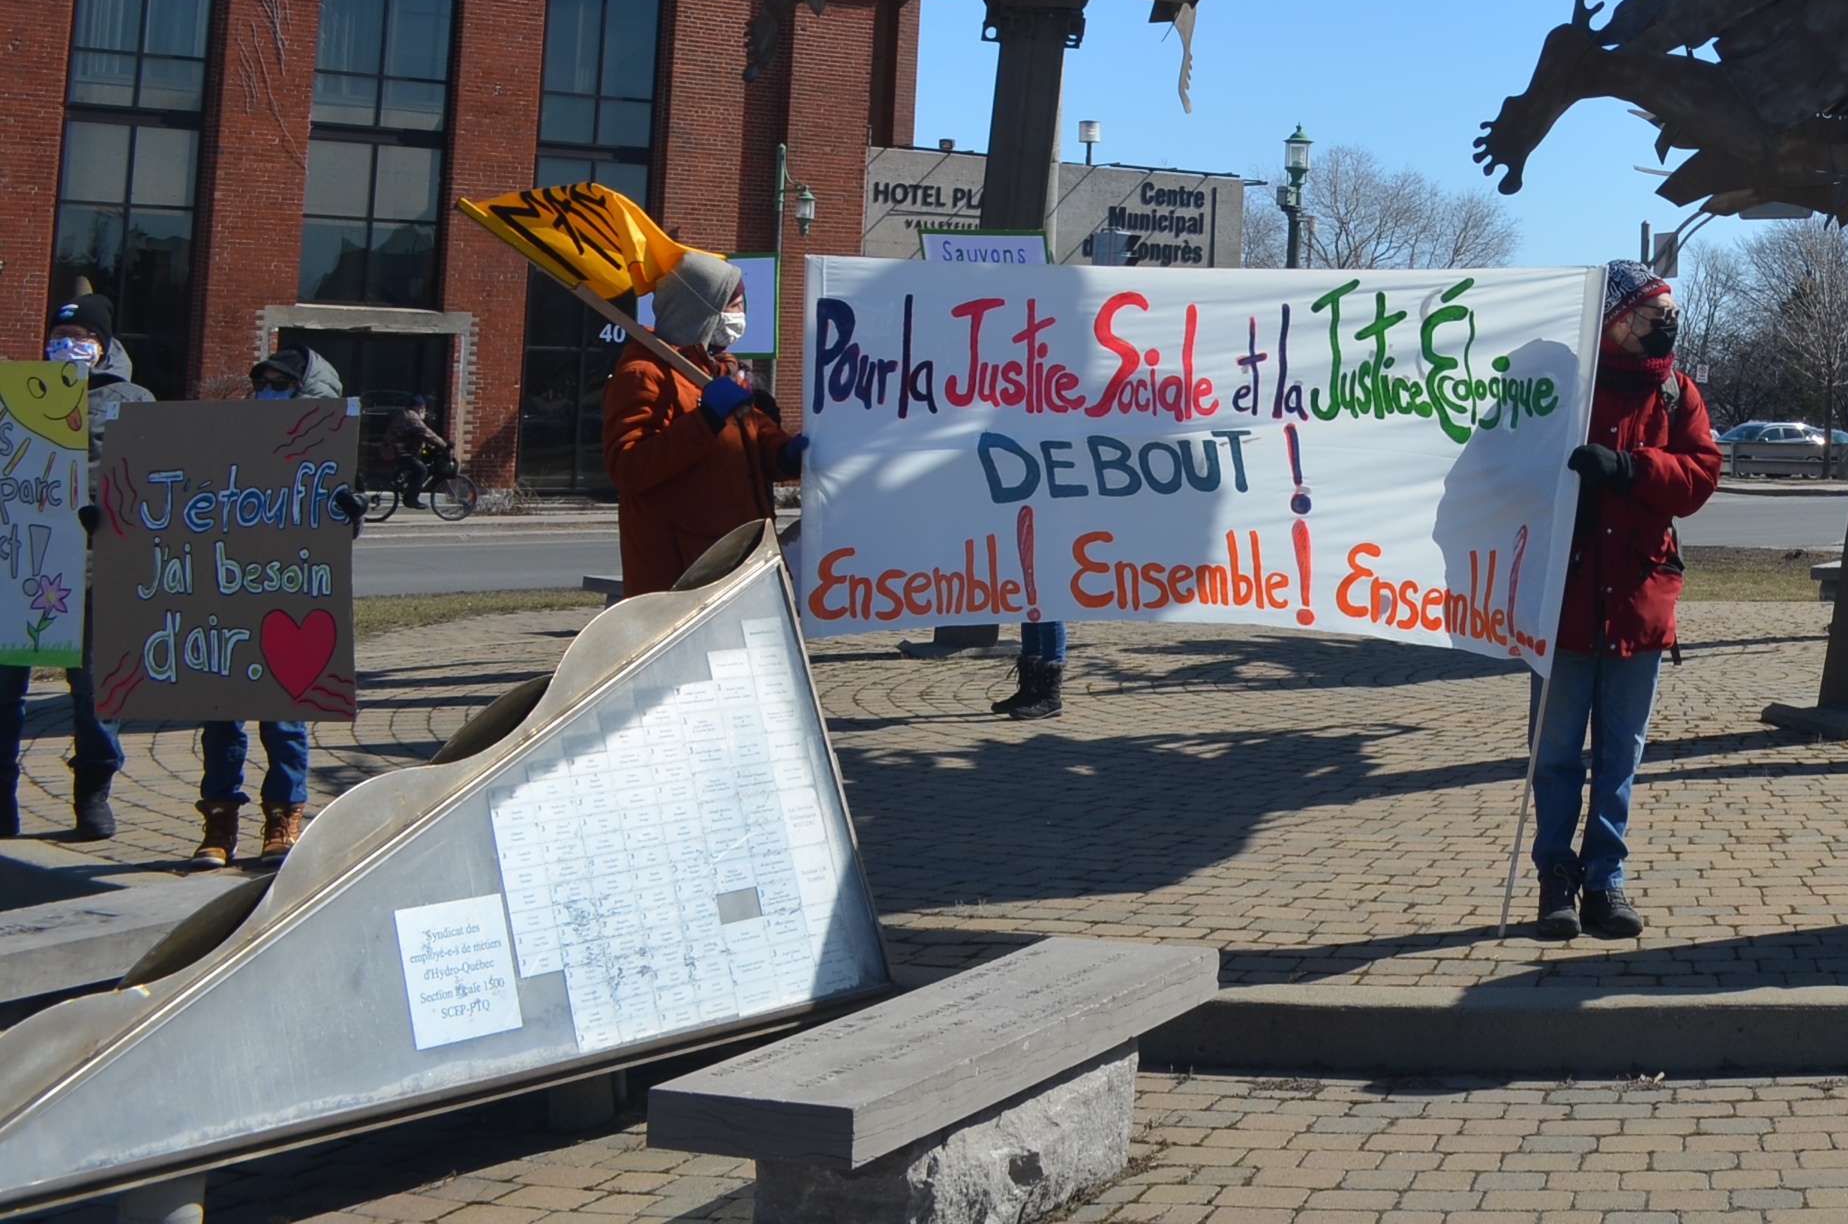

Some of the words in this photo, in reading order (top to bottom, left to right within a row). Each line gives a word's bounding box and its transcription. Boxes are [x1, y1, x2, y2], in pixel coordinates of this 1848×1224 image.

[873, 181, 946, 208] HOTEL
[1140, 181, 1205, 209] Centre
[1107, 205, 1204, 238] Municipal
[942, 240, 1026, 265] Sauvons
[1137, 239, 1203, 266] ongrès
[813, 297, 898, 415] Pour
[945, 297, 1086, 415] Justice
[1085, 290, 1220, 423] Sociale
[1231, 316, 1267, 416] et
[1272, 302, 1309, 421] la
[1310, 278, 1430, 423] Justice
[977, 429, 1251, 504] DEBOUT
[215, 540, 333, 597] besoin
[808, 505, 1042, 622] Ensemble!
[1070, 517, 1316, 626] Ensemble!
[425, 925, 464, 943] Syndicat
[466, 922, 481, 934] des
[461, 943, 472, 955] de
[473, 939, 503, 953] métiers
[423, 959, 495, 981] d'Hydro-Québec
[420, 988, 454, 1004] Section
[484, 977, 505, 992] 1500
